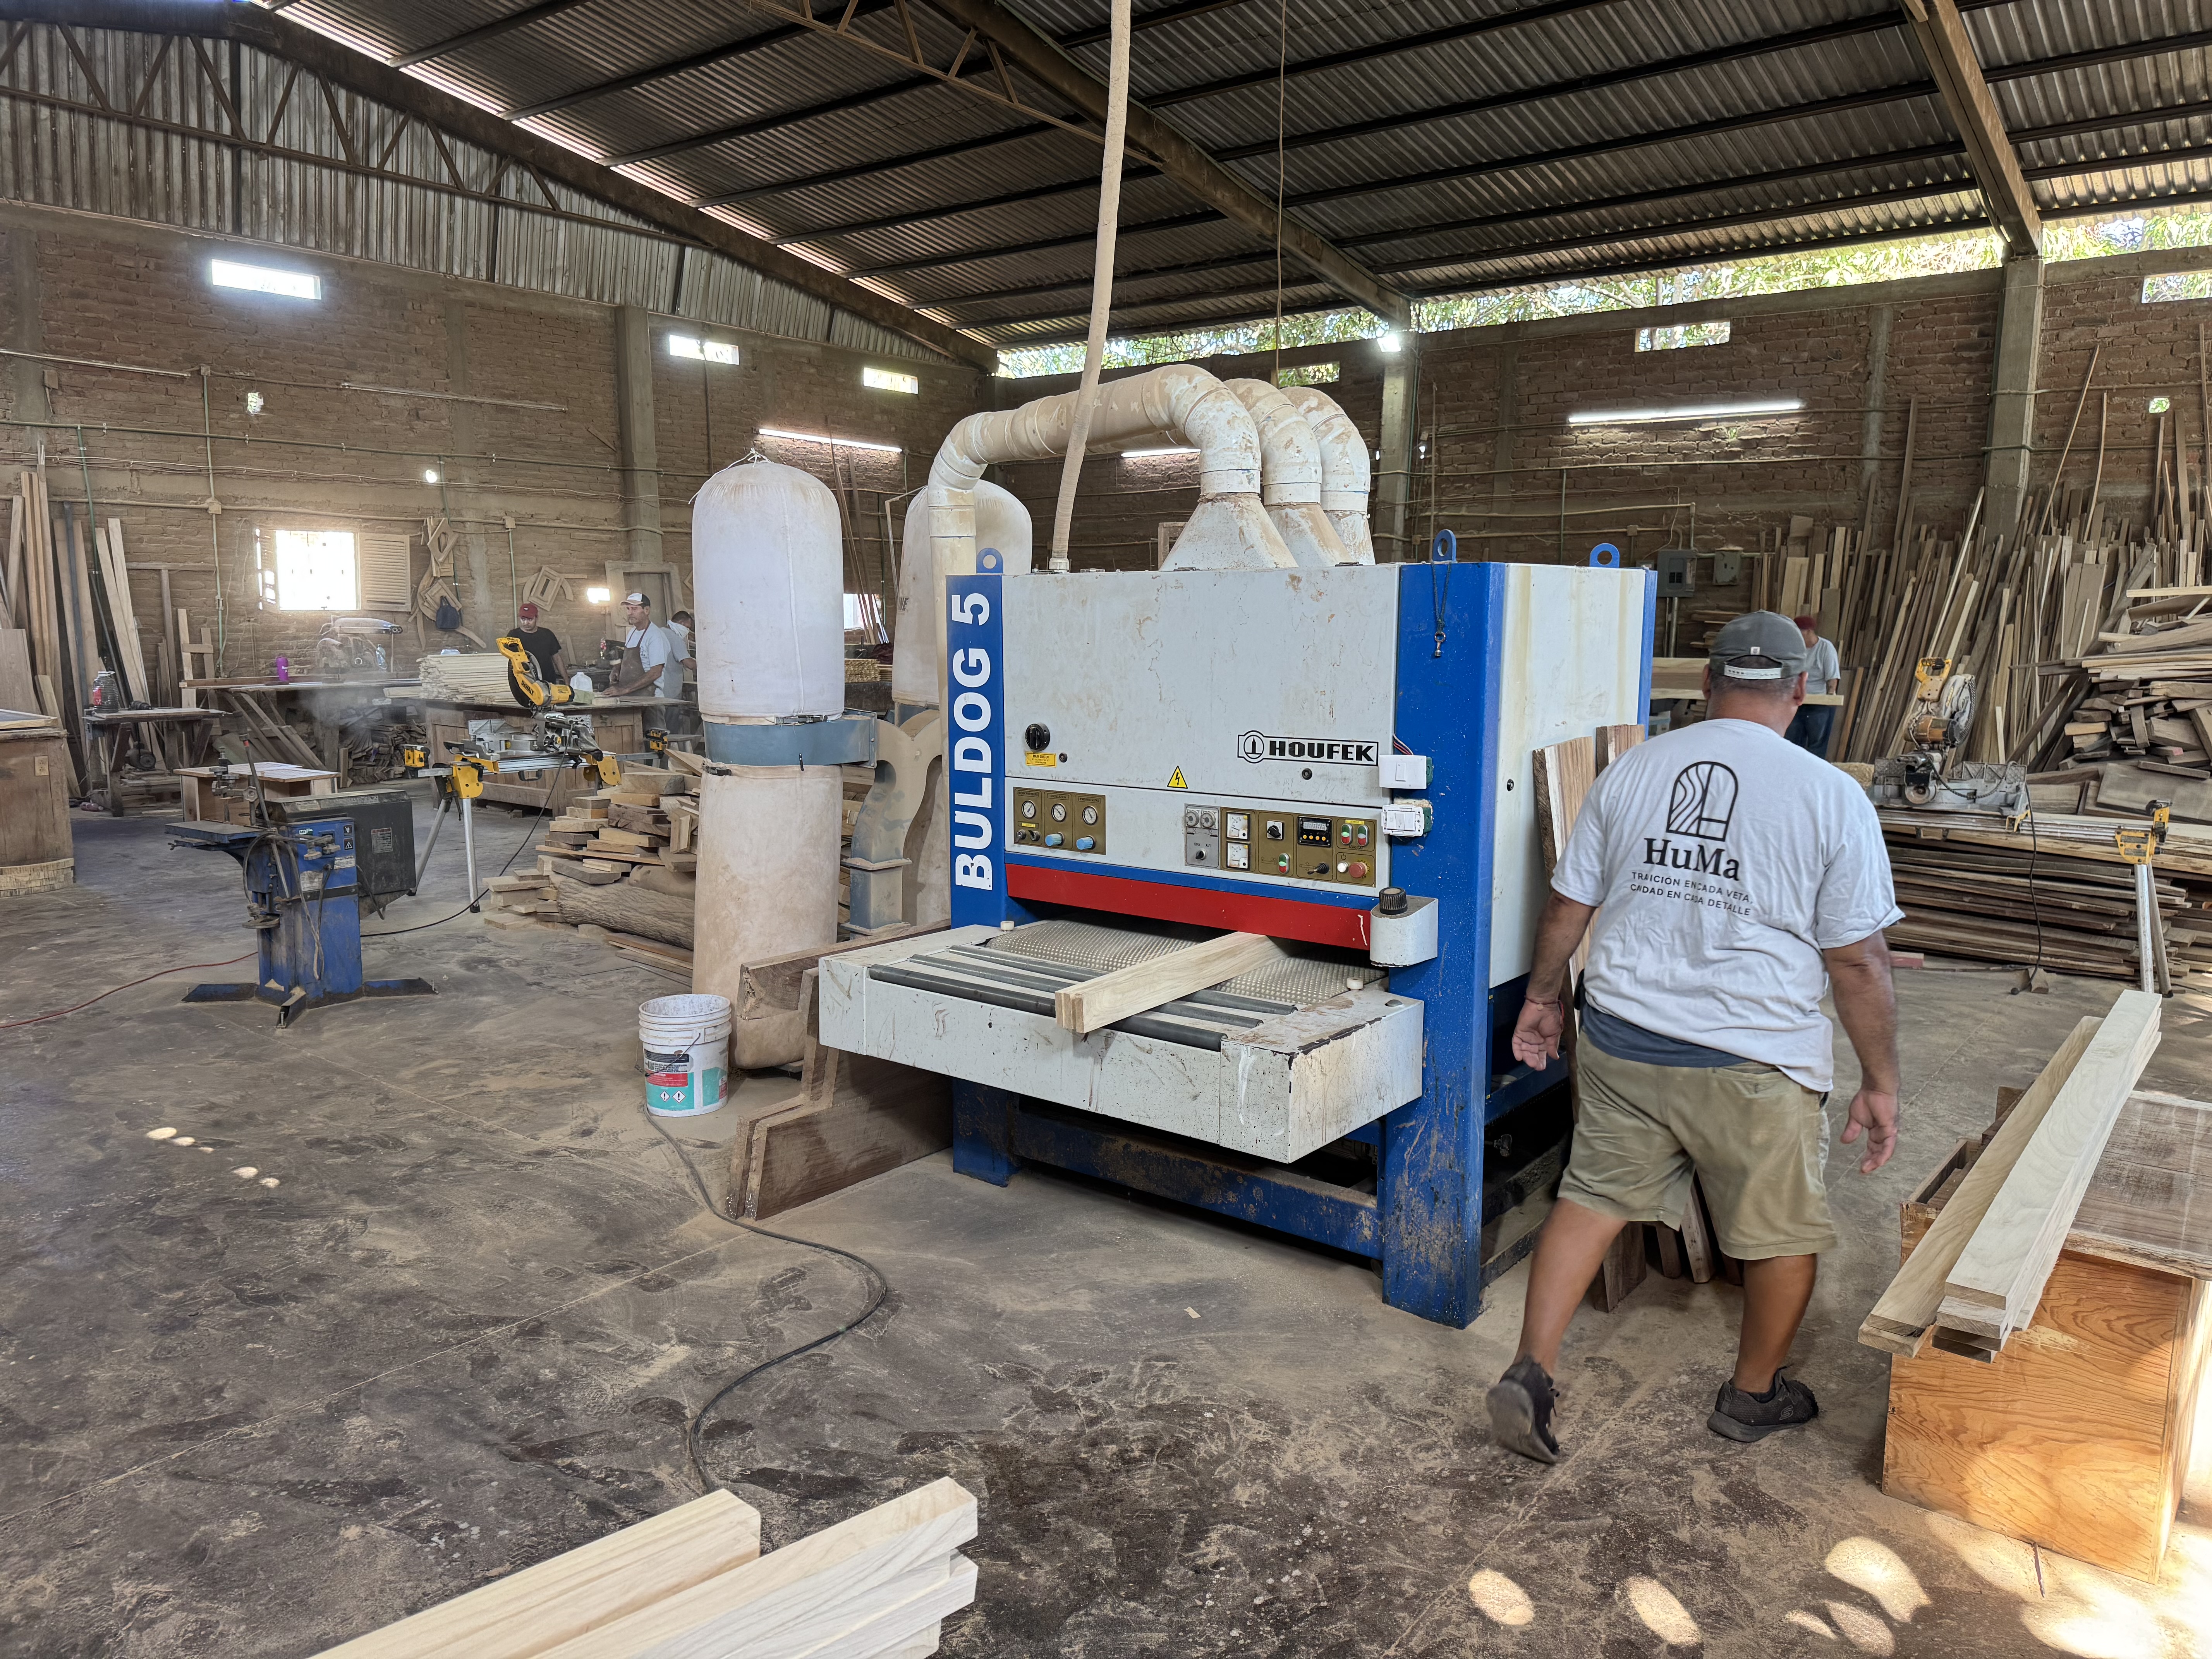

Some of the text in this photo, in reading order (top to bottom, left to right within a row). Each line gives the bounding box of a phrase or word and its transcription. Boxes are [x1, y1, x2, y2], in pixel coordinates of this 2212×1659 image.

[951, 592, 993, 891] BULDOG 5
[1269, 740, 1374, 762] HOUFEK
[1643, 838, 1740, 881] HuMa
[1707, 899, 1751, 915] DETALLE
[1726, 889, 1753, 904] VETA,
